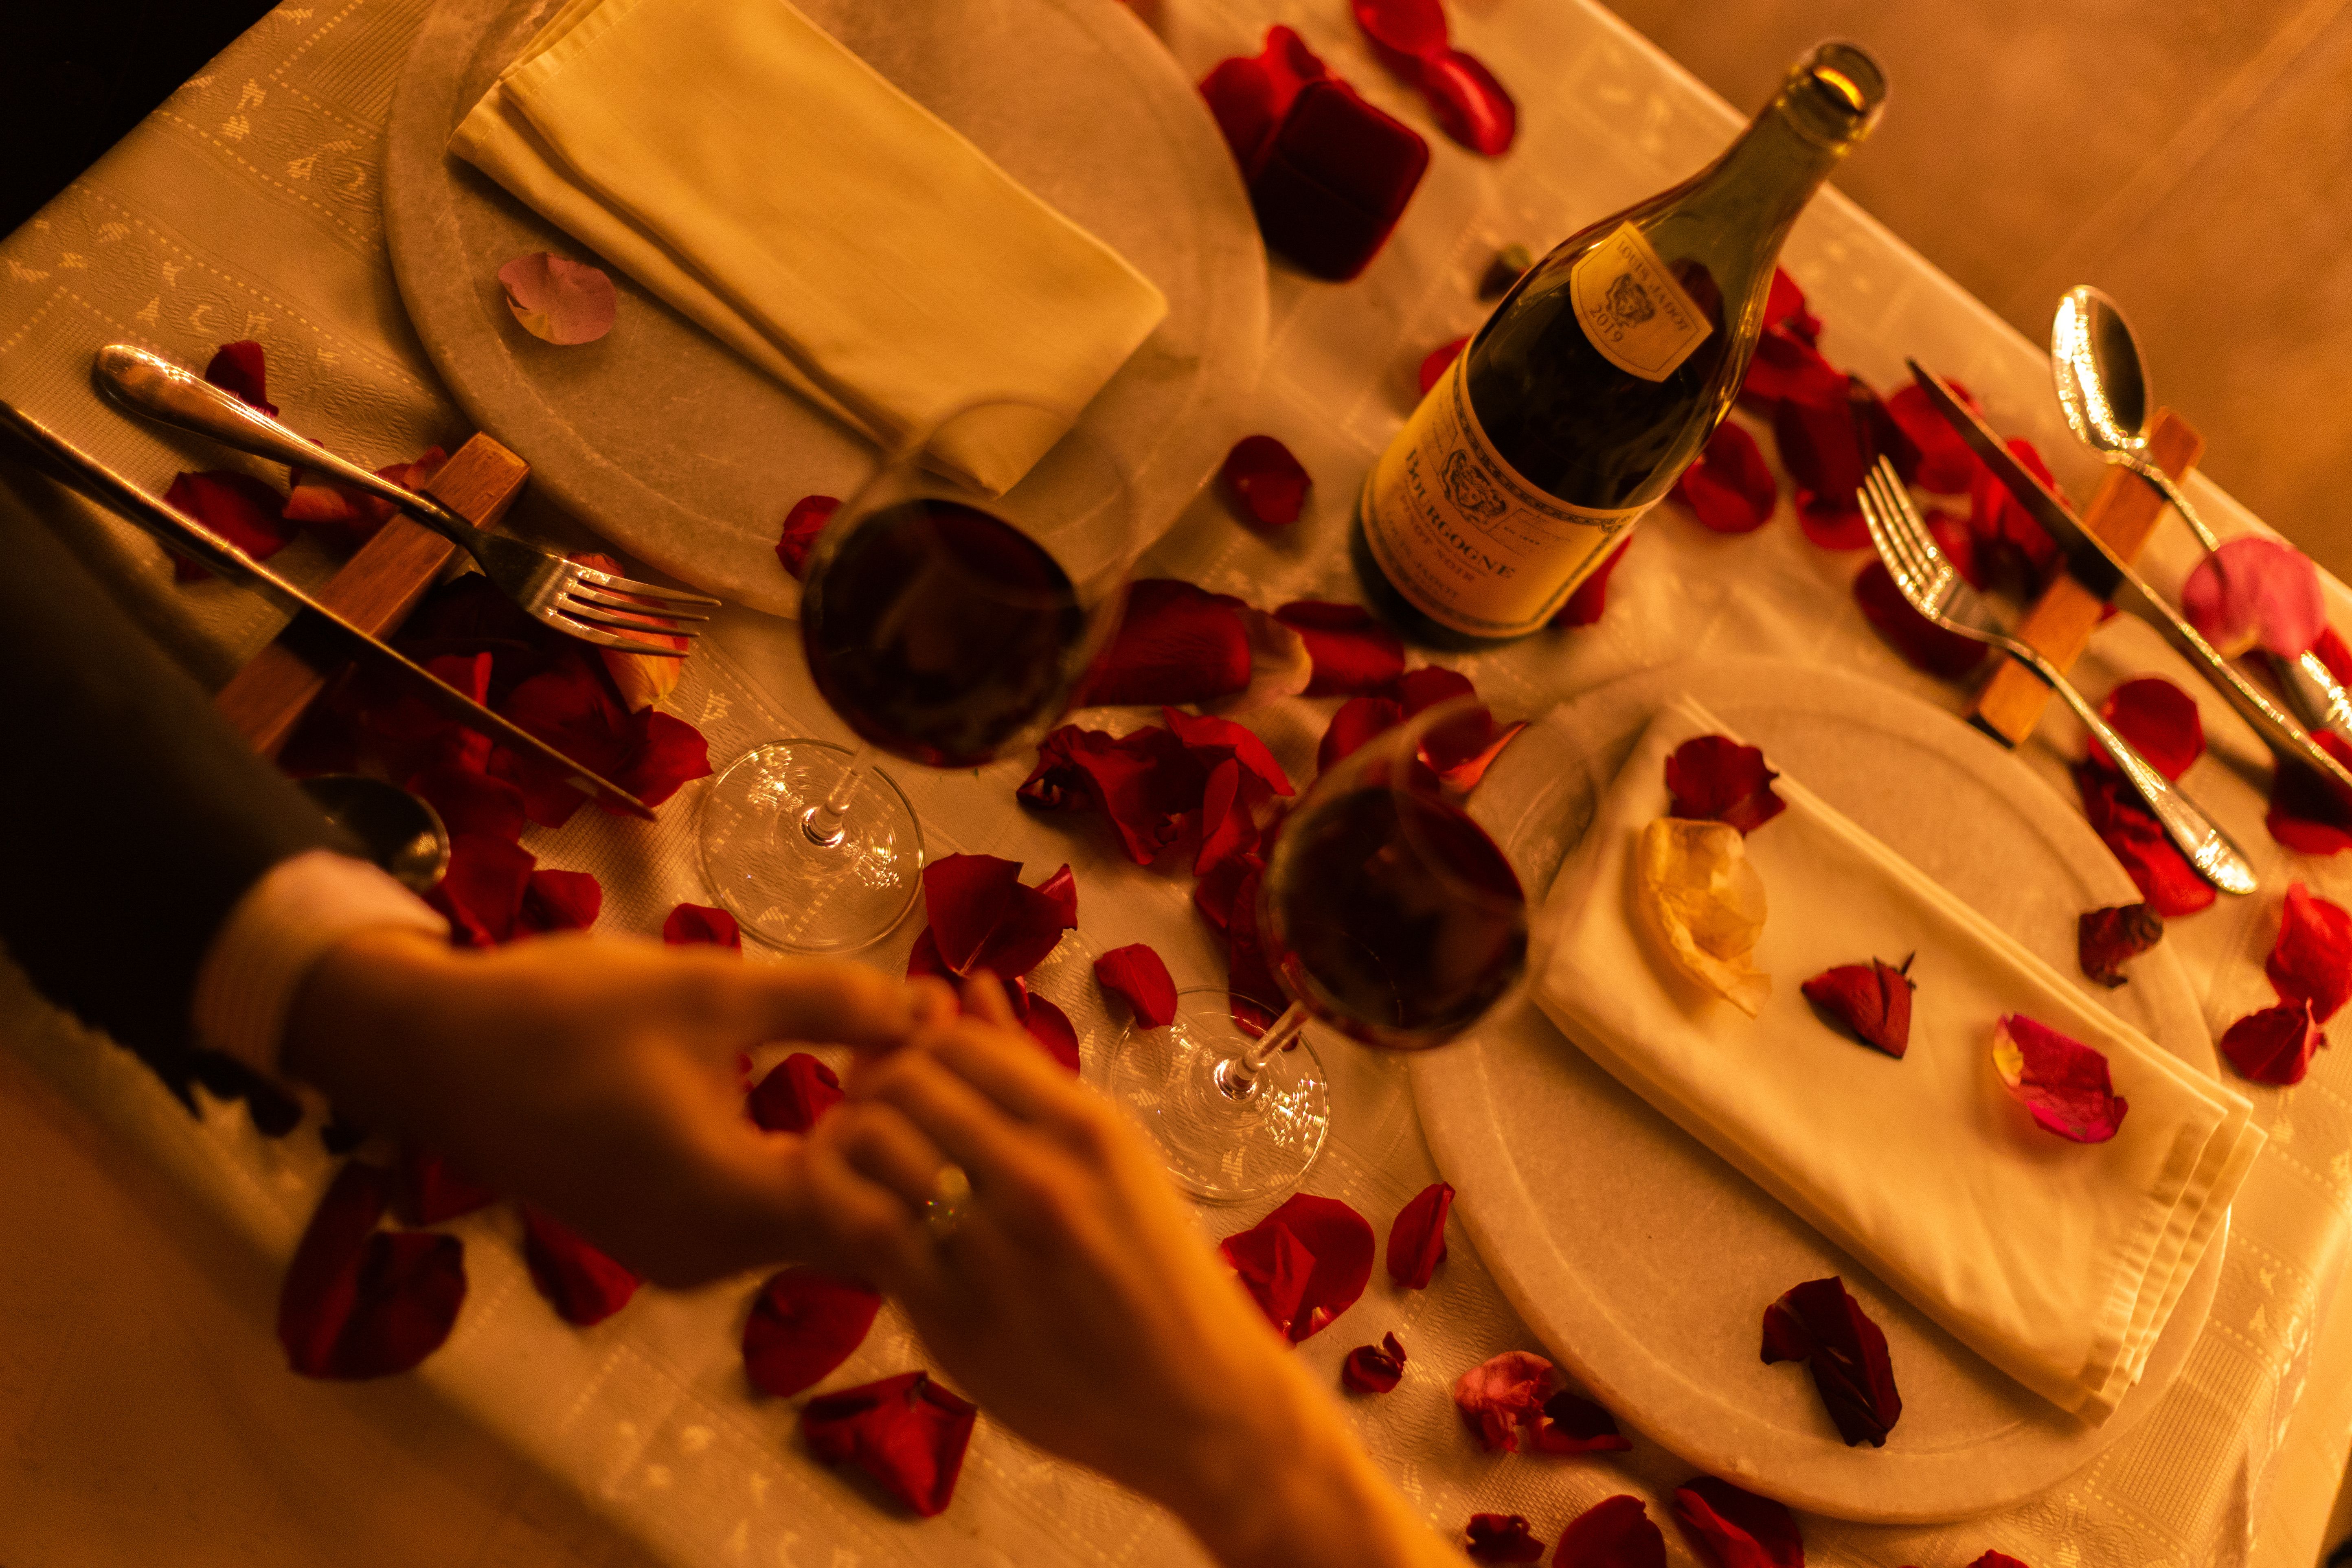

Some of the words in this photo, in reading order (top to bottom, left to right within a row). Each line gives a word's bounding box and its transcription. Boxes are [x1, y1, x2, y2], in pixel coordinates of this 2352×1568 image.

[1617, 241, 1649, 281] LOUIS
[1590, 304, 1623, 342] 2019
[1406, 448, 1515, 578] BOURGOGNE
[1434, 548, 1474, 582] NOIR
